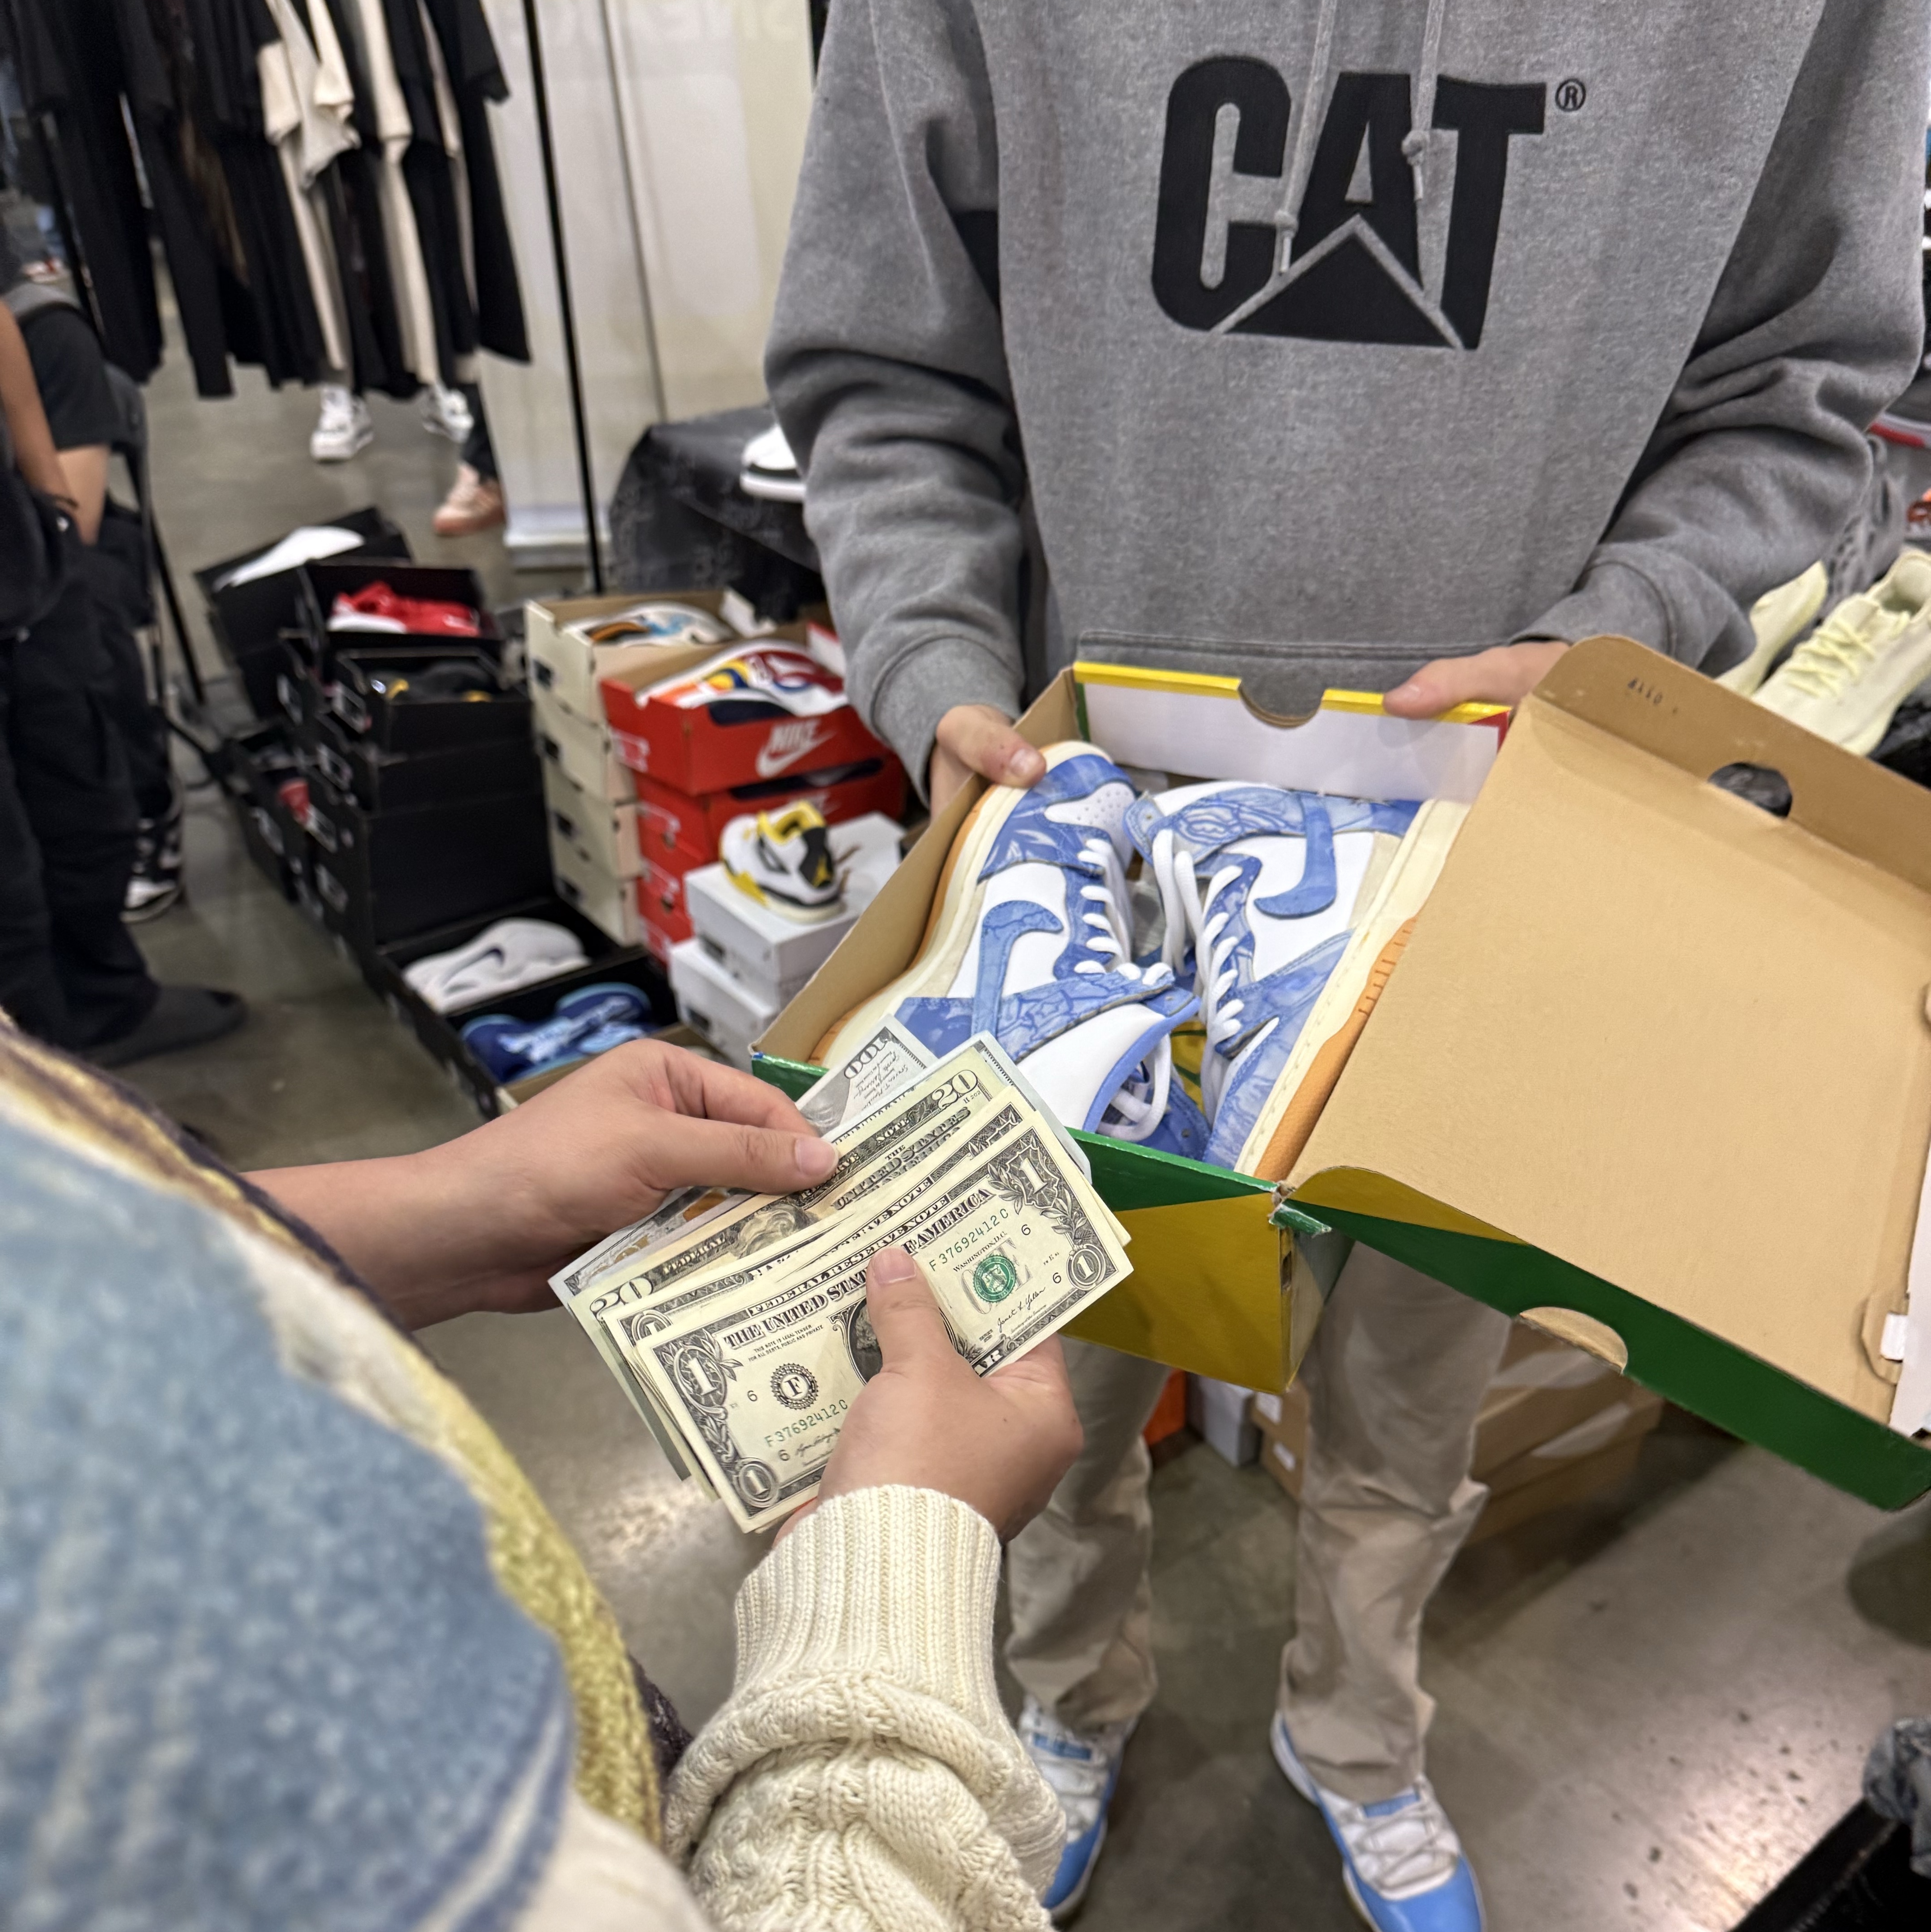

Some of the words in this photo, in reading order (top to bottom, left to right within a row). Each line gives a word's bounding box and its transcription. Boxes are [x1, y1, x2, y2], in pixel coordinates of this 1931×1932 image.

[1151, 55, 1546, 350] CAT
[931, 1069, 979, 1109] 20
[885, 1145, 905, 1160] THE
[1014, 1158, 1047, 1196] 1
[663, 1234, 726, 1275] FEDERAL
[875, 1116, 909, 1143] NOTE
[888, 1179, 931, 1215] NOTE
[1020, 1223, 1032, 1237] 6
[723, 1323, 766, 1350] THE
[761, 1292, 830, 1335] UNITED
[826, 1267, 867, 1303] STAT
[912, 1189, 993, 1249] AMERICA
[749, 1271, 830, 1315] FEDERAL
[827, 1226, 906, 1277] RESERVE
[903, 1197, 948, 1231] NOTE
[1076, 1255, 1095, 1278] 1
[1051, 1271, 1063, 1285] 6
[589, 1277, 654, 1320] 20
[684, 1356, 715, 1396] 1
[784, 1375, 804, 1398] F
[746, 1389, 758, 1403] 6
[776, 1448, 791, 1463] 6
[745, 1468, 768, 1496] 1
